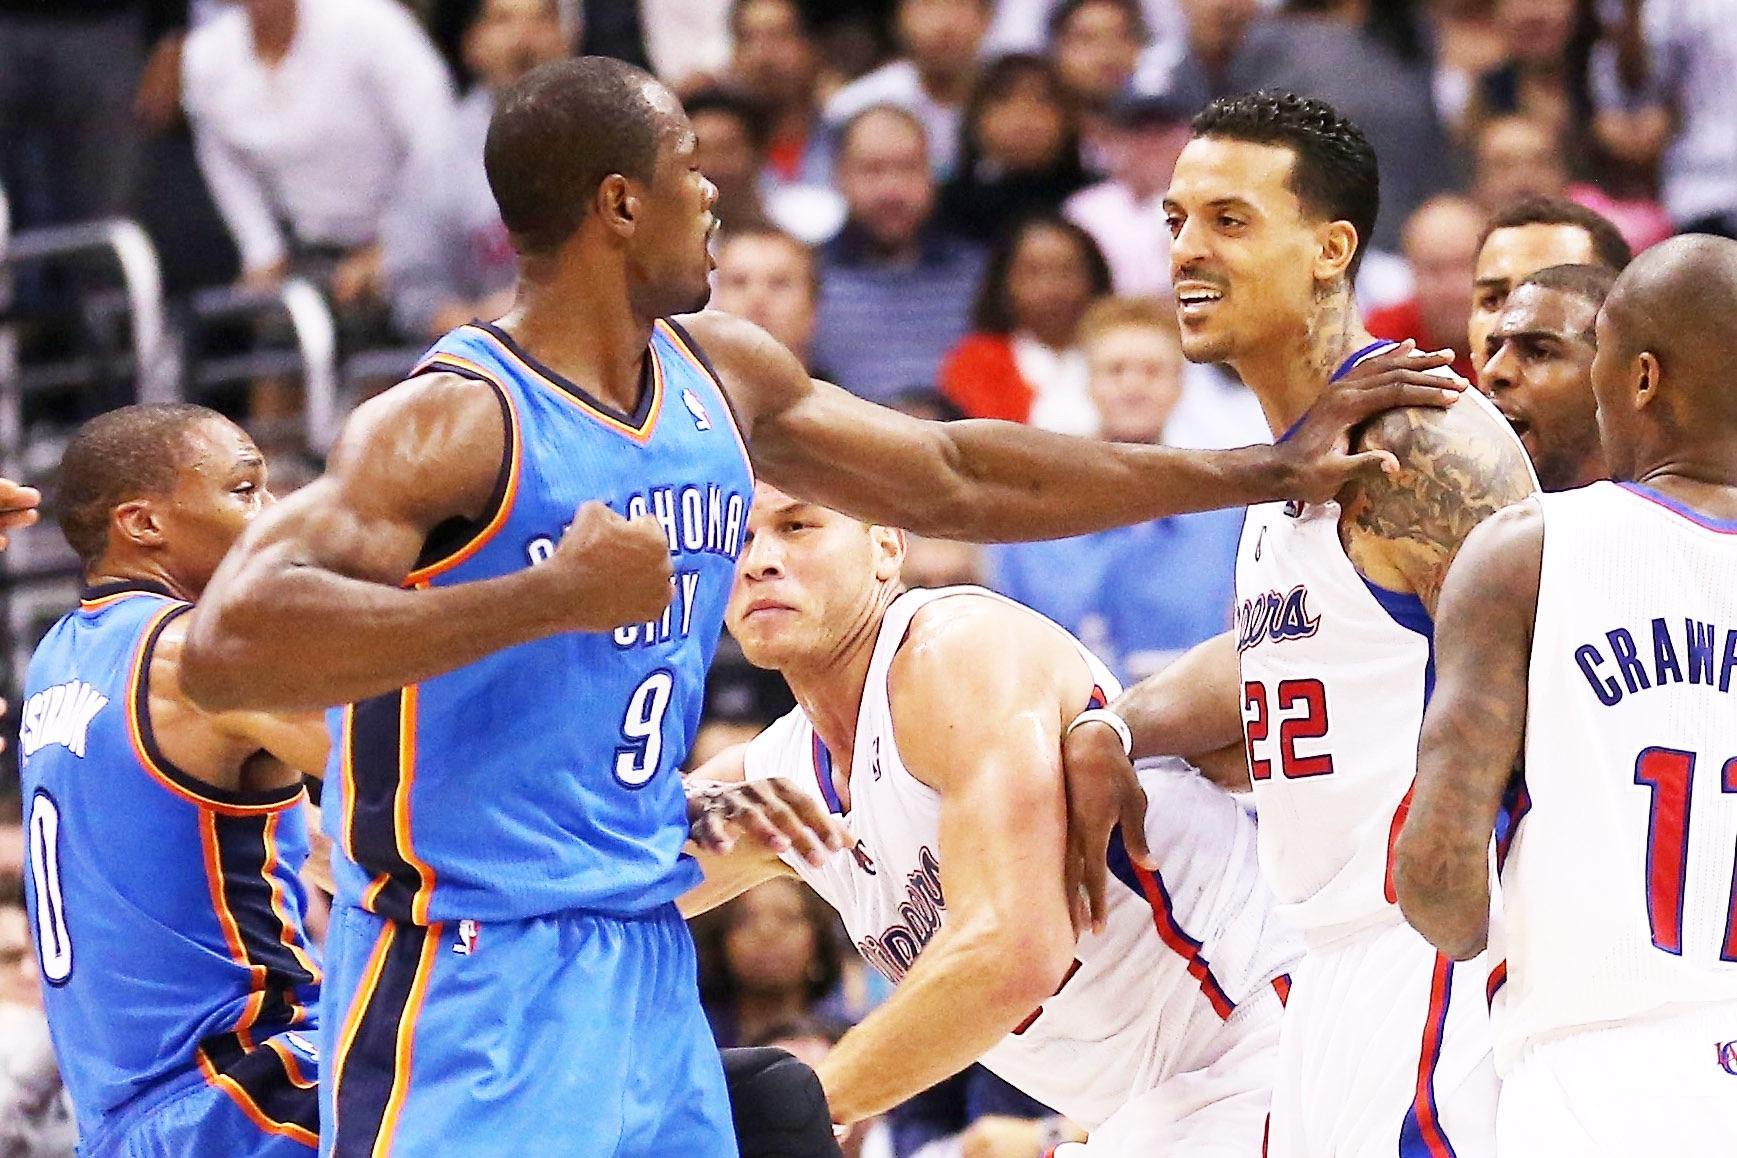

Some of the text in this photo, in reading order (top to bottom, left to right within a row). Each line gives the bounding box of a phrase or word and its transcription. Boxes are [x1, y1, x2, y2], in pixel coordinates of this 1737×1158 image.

[612, 668, 675, 790] 9
[1244, 678, 1334, 780] 22
[29, 786, 74, 988] 0
